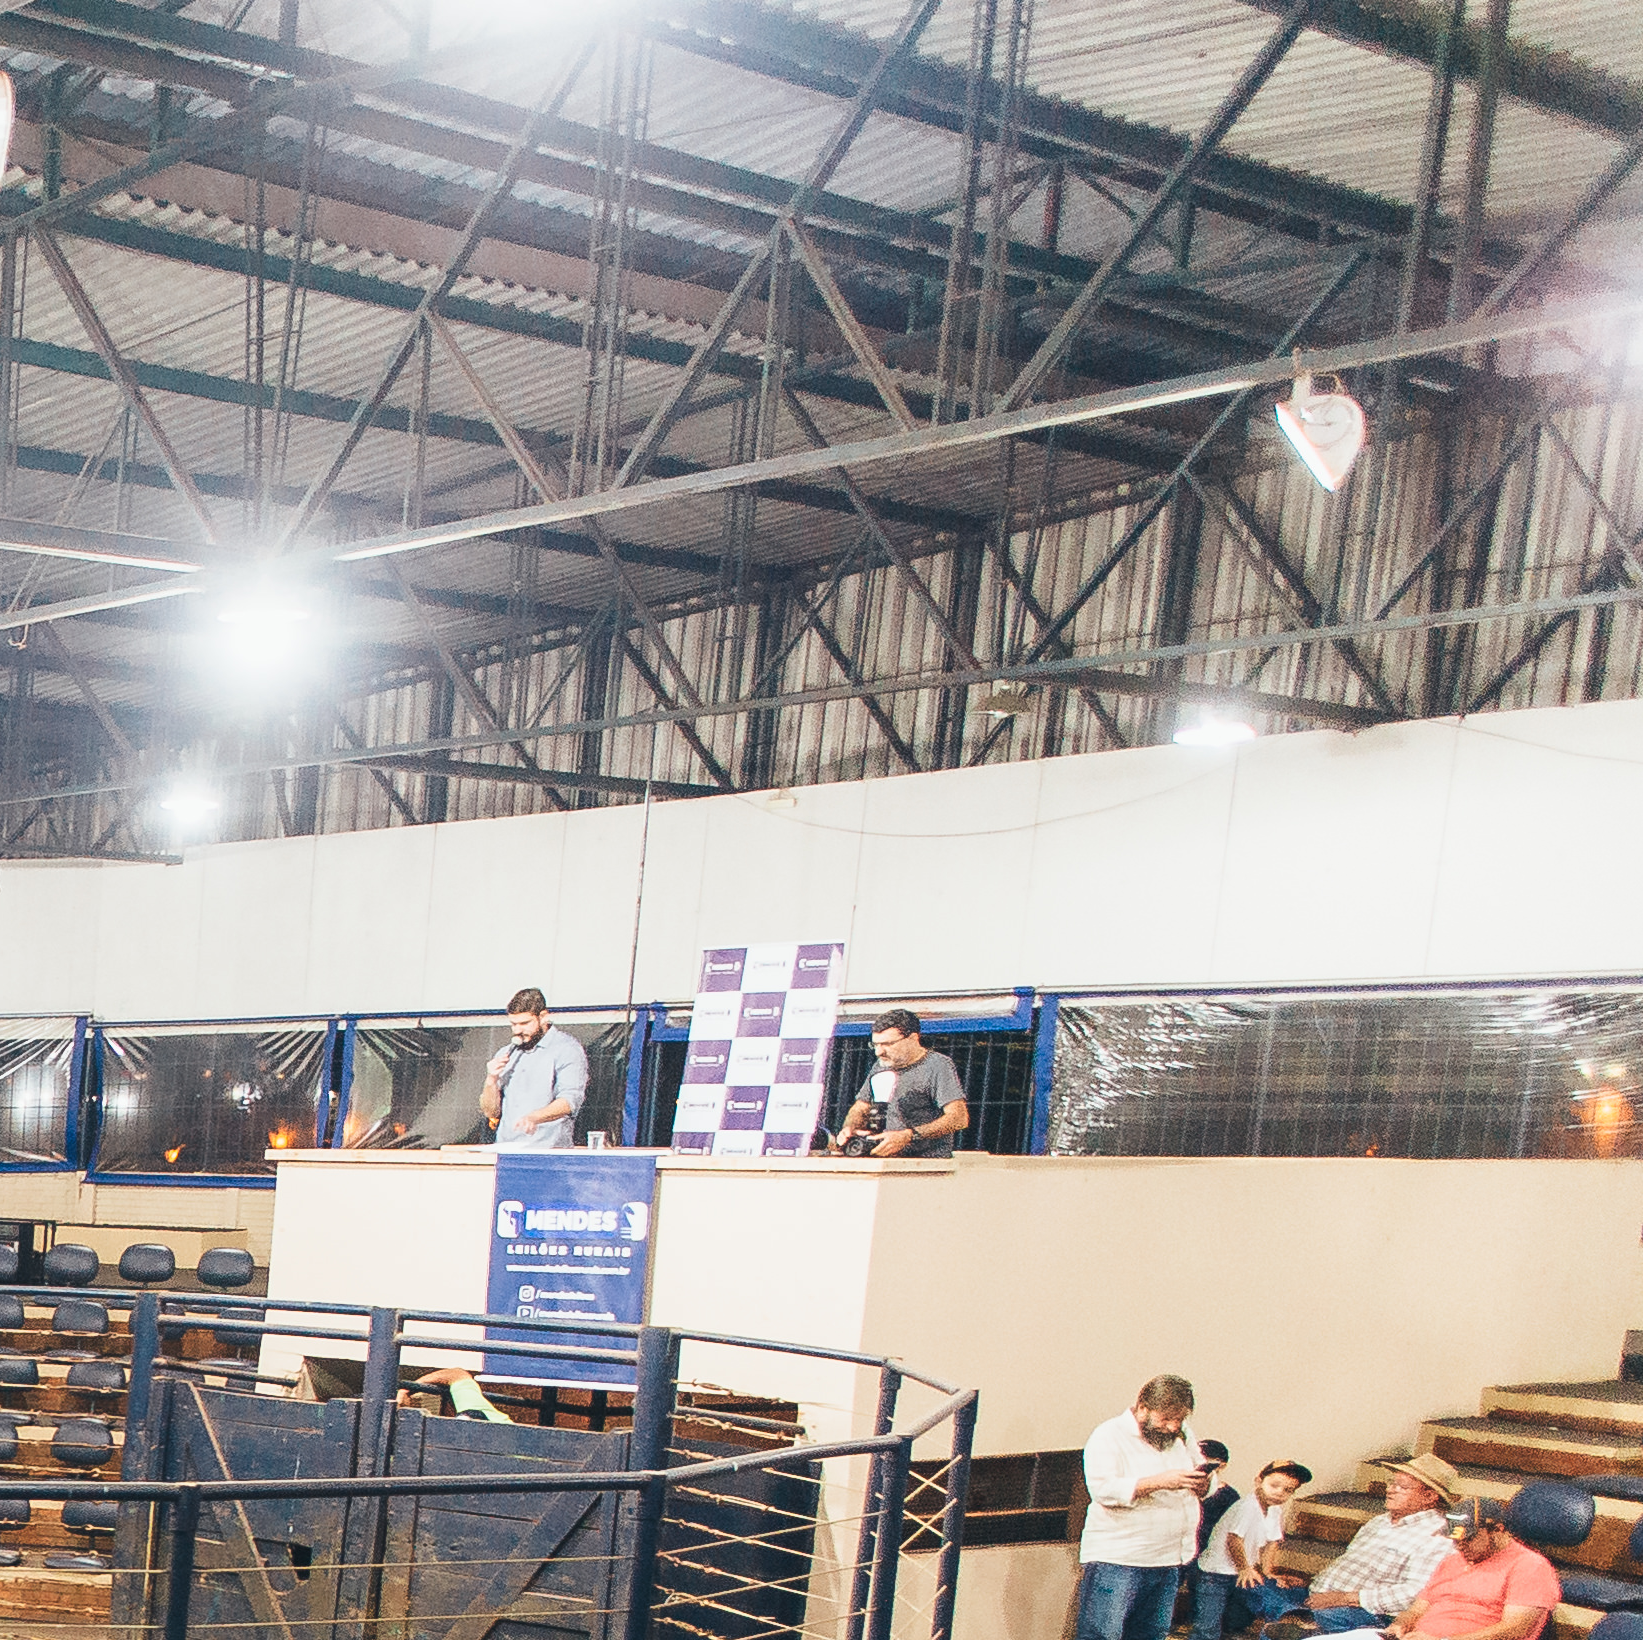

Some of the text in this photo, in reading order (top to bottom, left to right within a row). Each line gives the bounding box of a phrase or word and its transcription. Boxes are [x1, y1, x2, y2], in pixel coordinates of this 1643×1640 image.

[525, 1209, 618, 1231] MENDES
[506, 1243, 631, 1257] LEILÕES RURAIS
